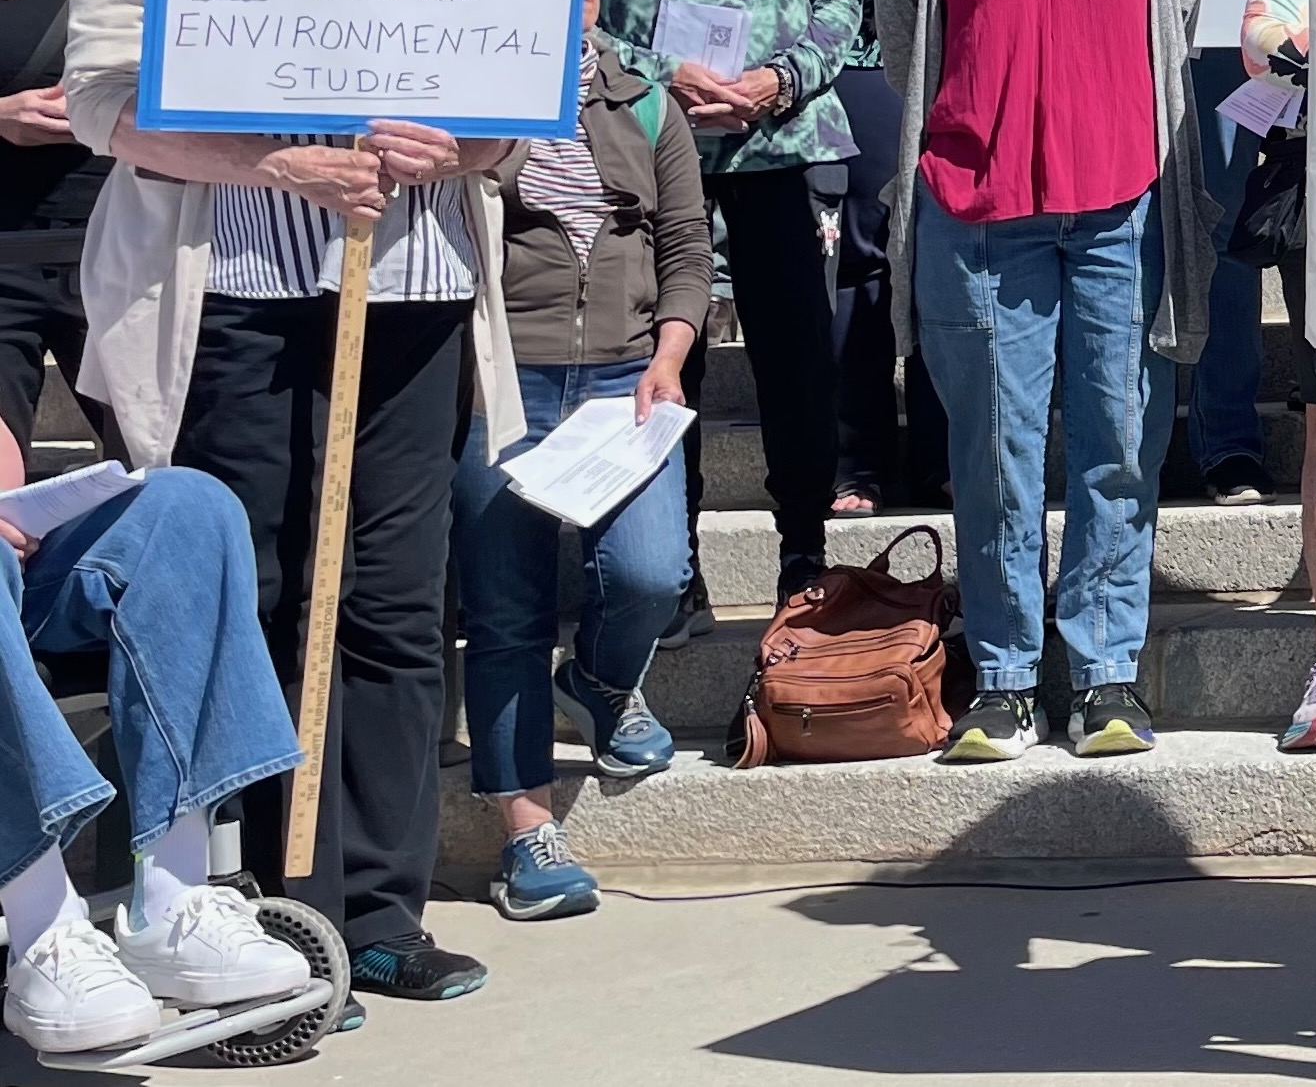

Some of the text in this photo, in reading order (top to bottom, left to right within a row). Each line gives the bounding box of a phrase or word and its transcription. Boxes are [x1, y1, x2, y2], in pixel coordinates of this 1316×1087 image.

[175, 13, 552, 58] ENVIRONMENTAL
[267, 62, 441, 93] STUDIES
[307, 594, 337, 802] THE GRANITE FURNITURE SUPERSTORES
